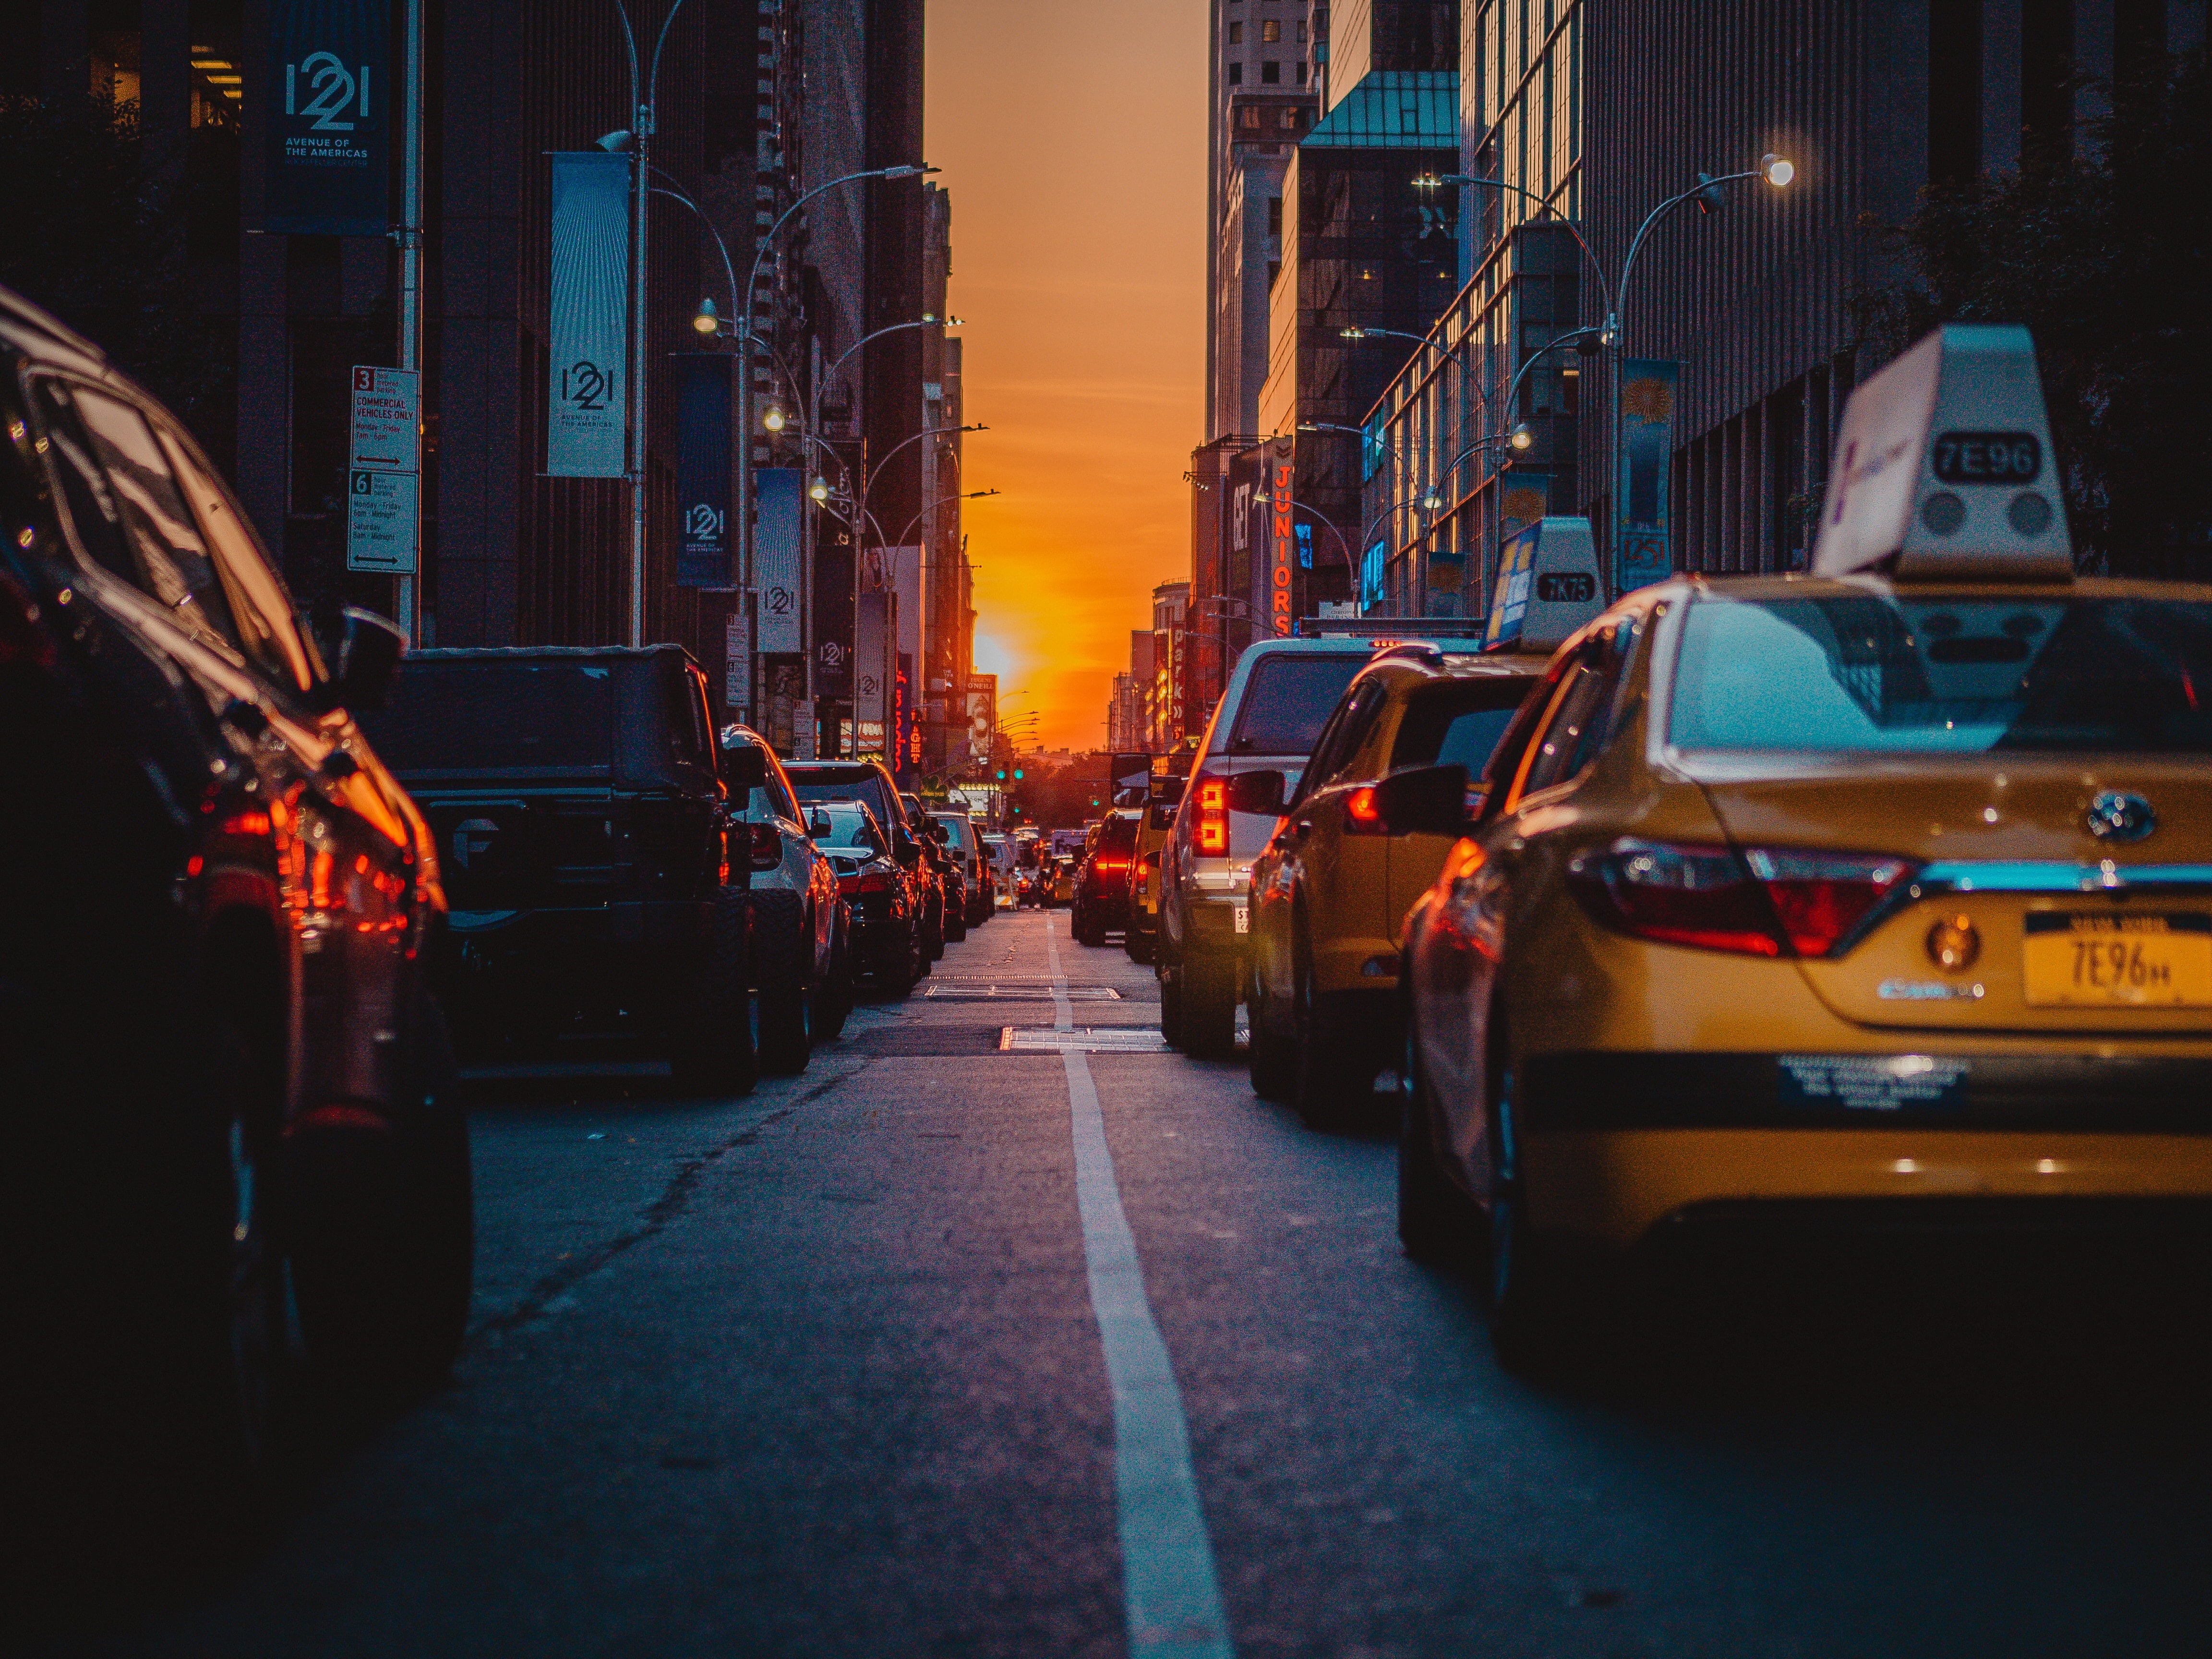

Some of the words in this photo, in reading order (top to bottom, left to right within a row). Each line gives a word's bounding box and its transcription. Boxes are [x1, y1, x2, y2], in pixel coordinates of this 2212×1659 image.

[285, 50, 369, 131] 1221
[286, 137, 331, 147] AVENUE
[335, 139, 350, 147] OF
[286, 147, 307, 156] THE
[311, 148, 368, 158] AMERICAS
[359, 370, 370, 389] 3
[562, 361, 613, 410] 1221
[357, 397, 406, 409] COMMERCIAL
[357, 408, 392, 420] VEHICLES
[394, 411, 413, 421] ONLY
[356, 422, 378, 431] Monday
[383, 424, 401, 433] Friday
[1941, 441, 2034, 474] 7E96
[356, 474, 367, 493] 6
[354, 500, 377, 509] Monday
[383, 502, 401, 511] Friday
[371, 511, 396, 519] Midnight
[353, 522, 381, 531] Saturday
[685, 502, 724, 541] 1221
[371, 533, 395, 541] Midnight
[1624, 538, 1665, 569] 1251
[1548, 577, 1588, 601] 7K75
[764, 586, 794, 615] 1221
[820, 642, 844, 666] 1221
[1174, 629, 1183, 700] park
